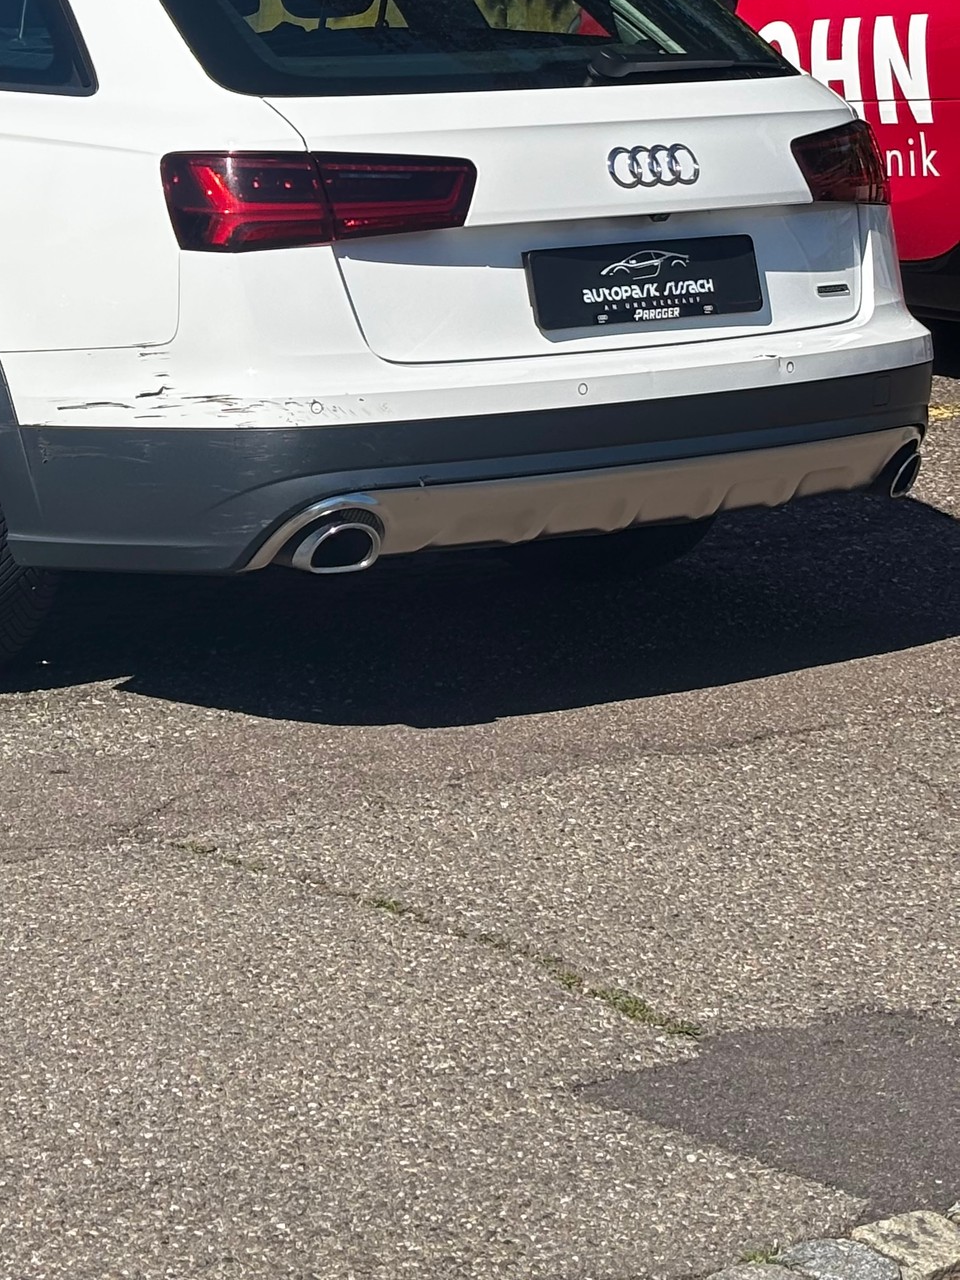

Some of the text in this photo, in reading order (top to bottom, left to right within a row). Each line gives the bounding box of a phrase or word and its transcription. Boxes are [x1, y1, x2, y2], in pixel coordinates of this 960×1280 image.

[625, 301, 647, 310] UND
[652, 296, 701, 307] VERKAUF
[633, 307, 680, 321] PARGGER
